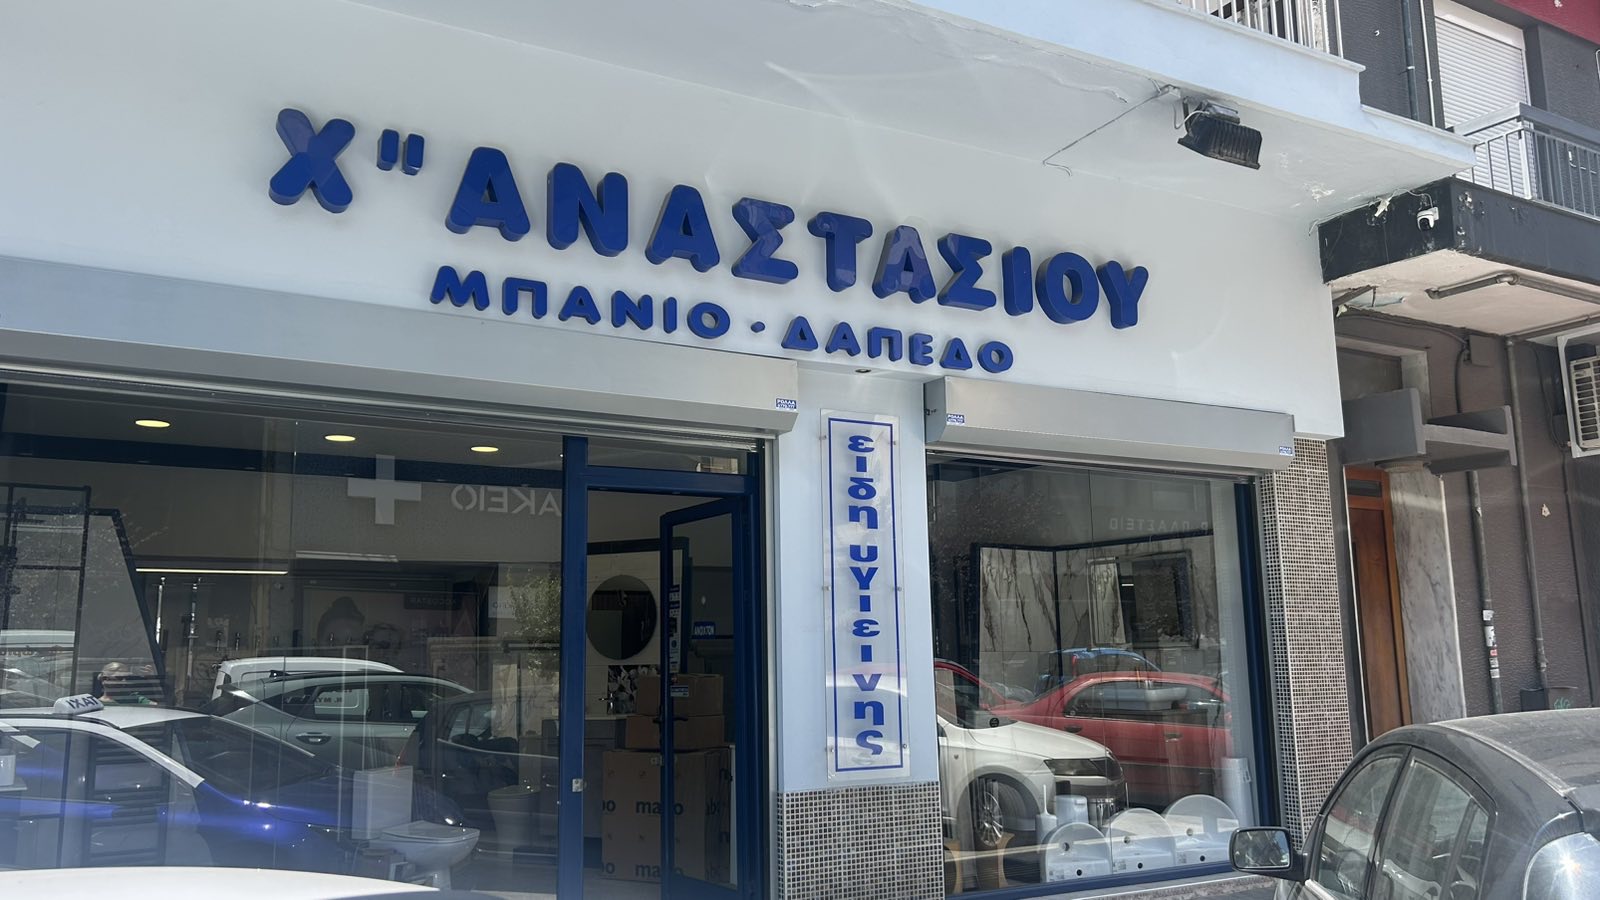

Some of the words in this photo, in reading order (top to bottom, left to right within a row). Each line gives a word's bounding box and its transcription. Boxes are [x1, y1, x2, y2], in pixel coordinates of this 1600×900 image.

[430, 265, 731, 339] ΜΠΑΝΙΟ
[780, 315, 1014, 374] ΔΑΠΕΔΟ
[848, 435, 879, 530] ειδη
[850, 544, 884, 756] υγιεινης
